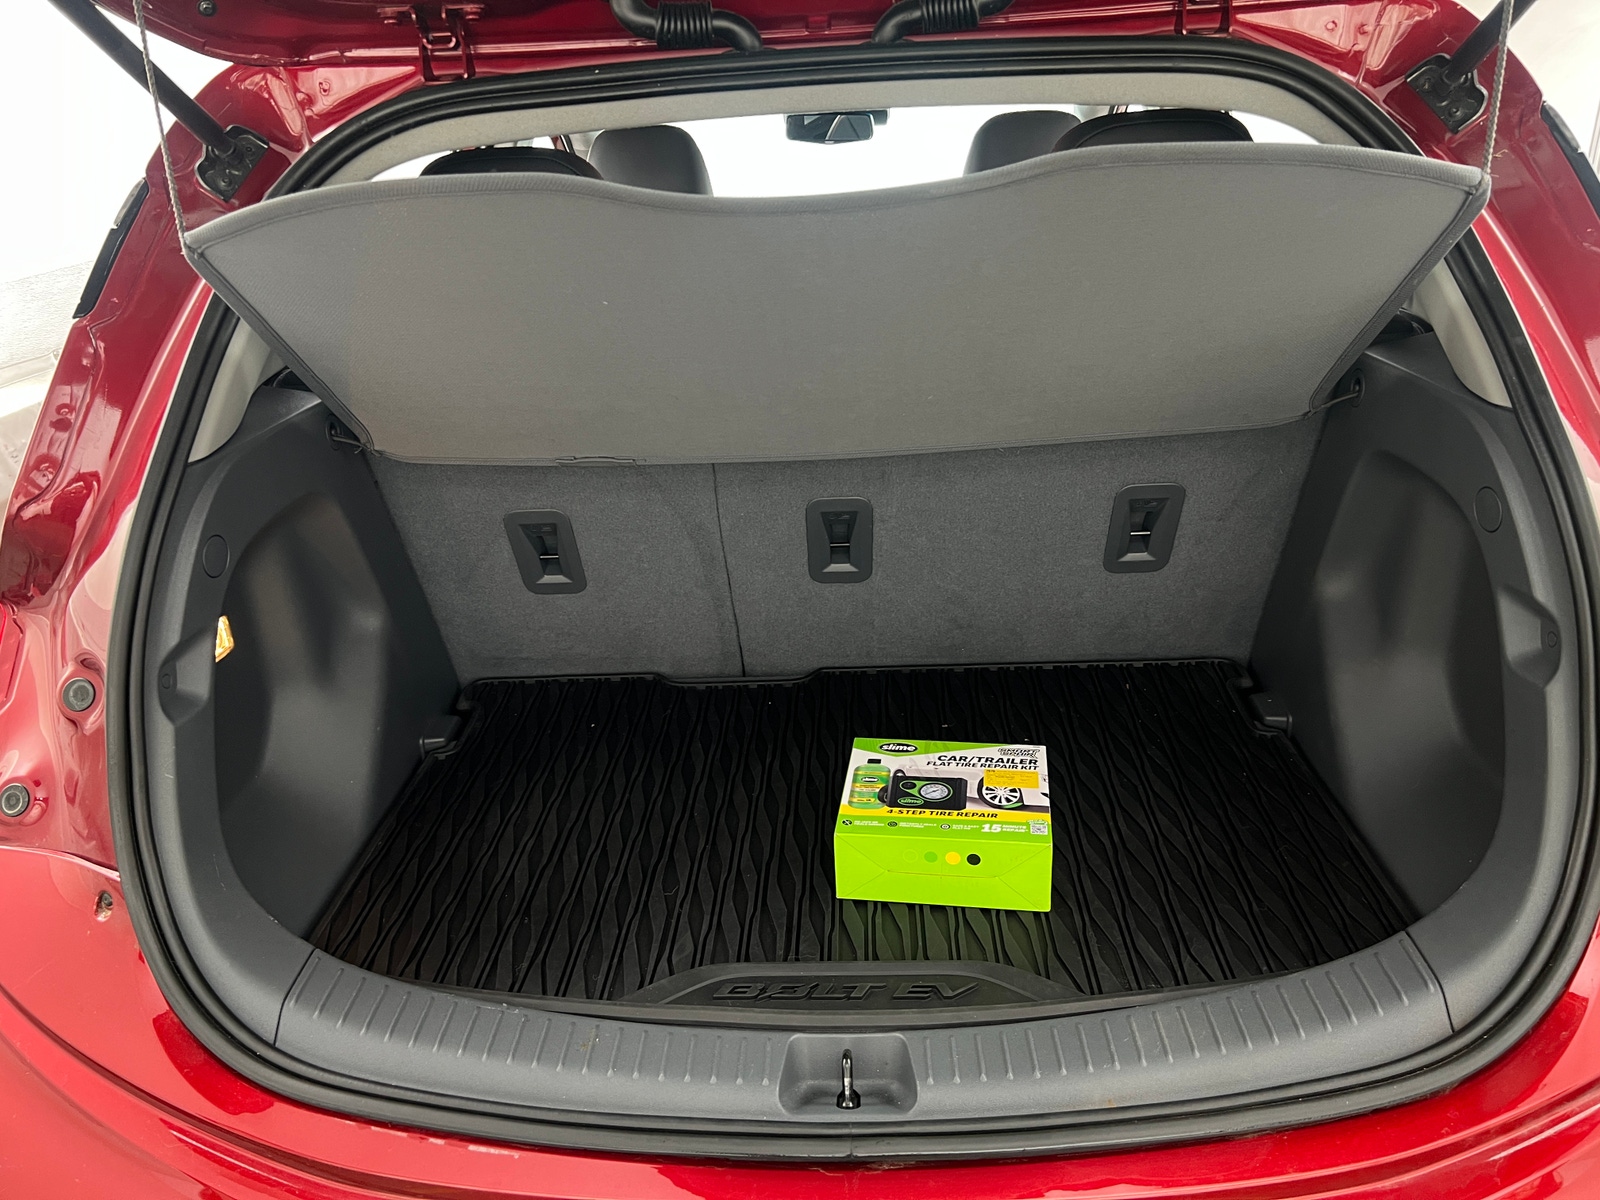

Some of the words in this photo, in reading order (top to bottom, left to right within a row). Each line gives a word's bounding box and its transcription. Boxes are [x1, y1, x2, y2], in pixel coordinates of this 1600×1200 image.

[881, 743, 916, 752] slime
[937, 754, 1039, 766] CAR/TRAILER
[956, 811, 998, 819] REPAIR
[981, 823, 1002, 833] 15
[892, 981, 980, 1001] EV
